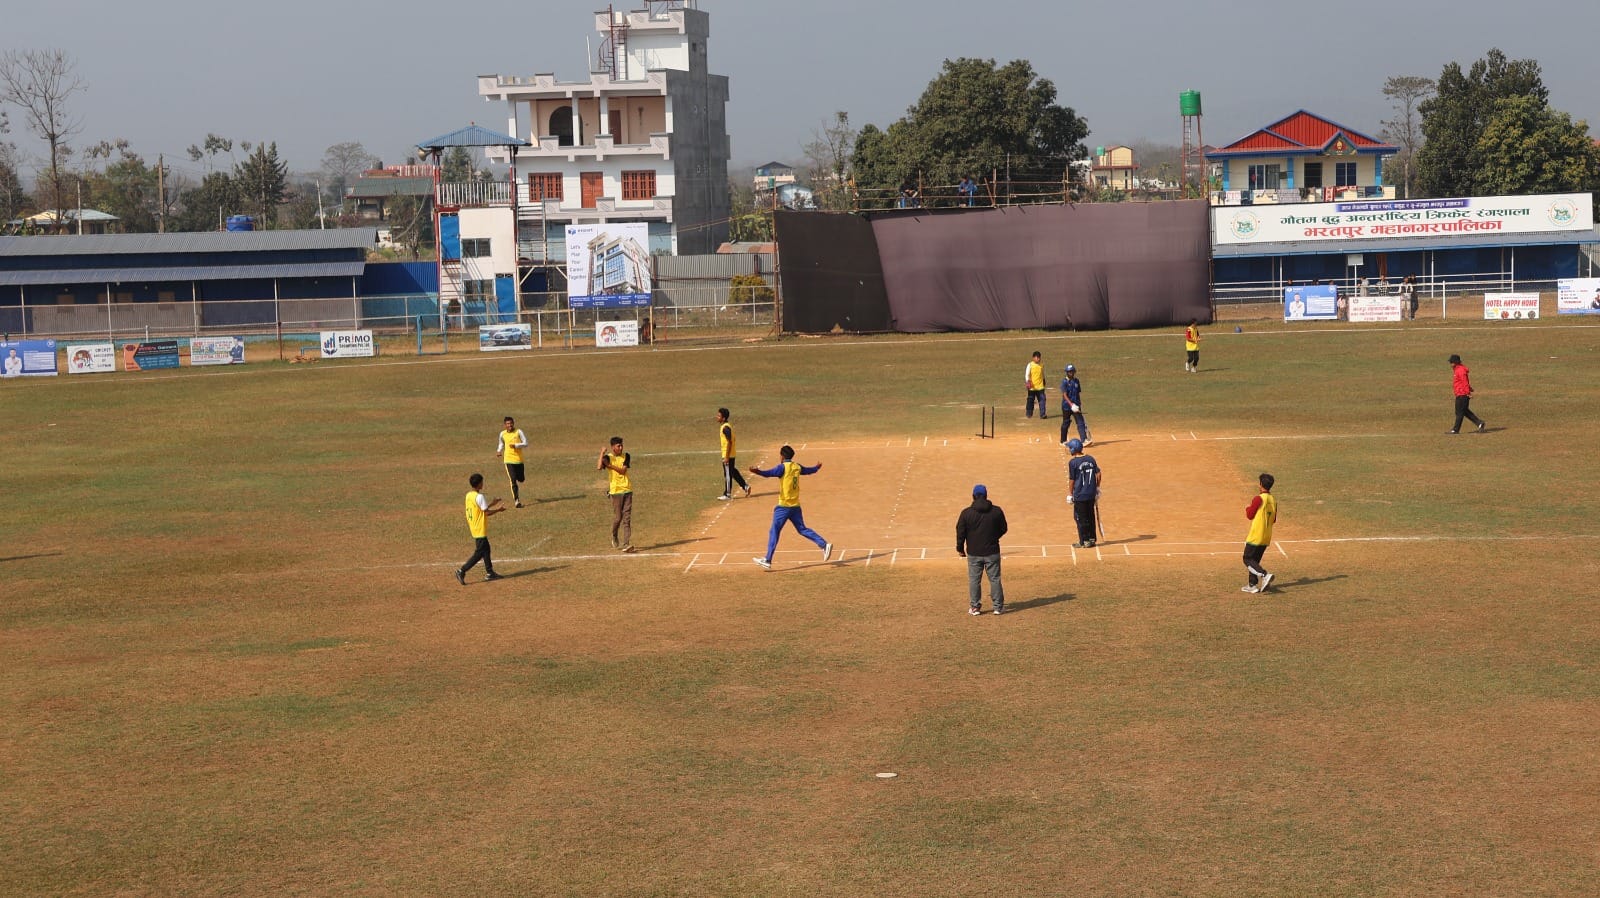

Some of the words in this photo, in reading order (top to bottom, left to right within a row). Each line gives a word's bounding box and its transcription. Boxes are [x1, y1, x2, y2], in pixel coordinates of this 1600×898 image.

[1280, 214, 1317, 224] गौतम
[1322, 215, 1340, 225] बुद्ध
[1426, 208, 1470, 219] क्रिकेट
[1477, 207, 1530, 217] रंगशाला
[1304, 226, 1363, 238] भरतपुर
[1371, 219, 1503, 235] महानगरपालिका
[1080, 468, 1093, 486] 17
